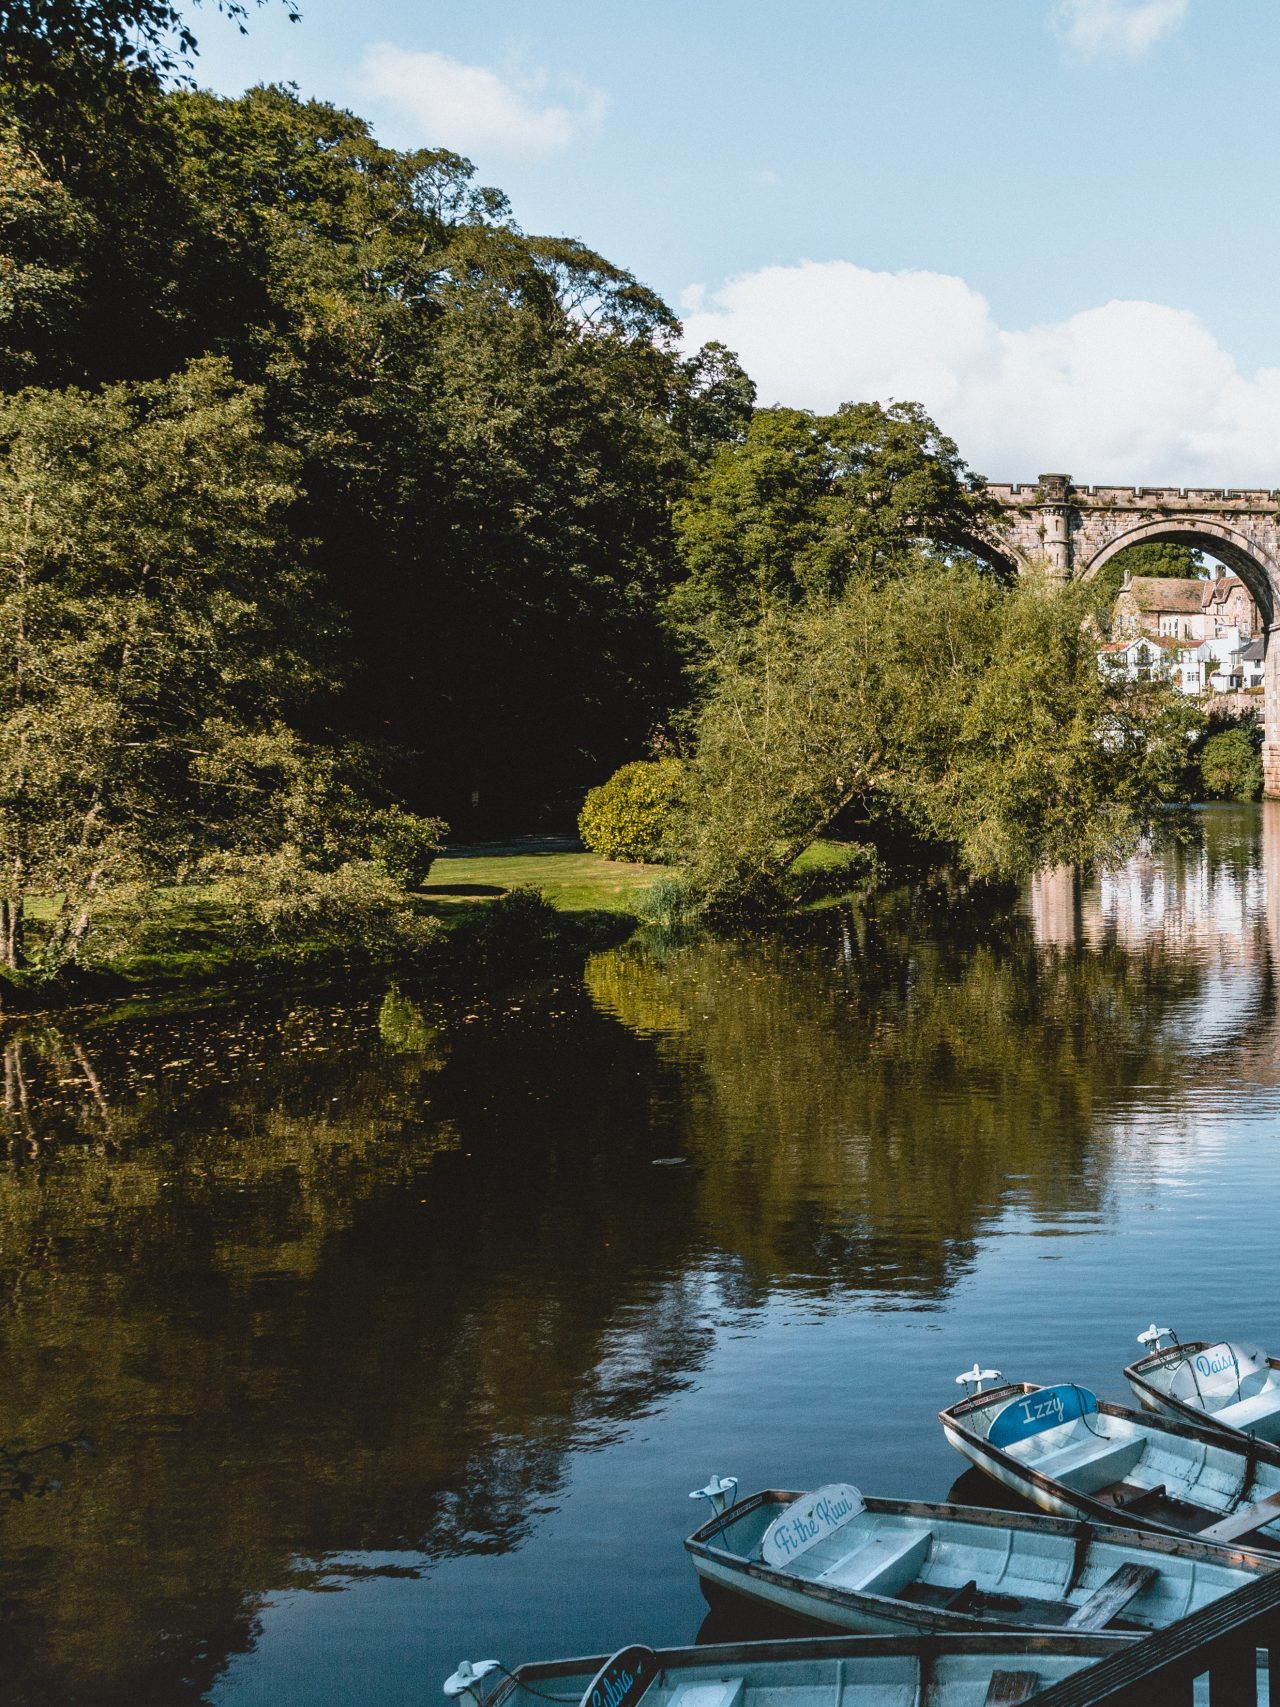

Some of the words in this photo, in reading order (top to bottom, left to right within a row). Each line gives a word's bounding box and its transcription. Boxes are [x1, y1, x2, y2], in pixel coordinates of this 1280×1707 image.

[1196, 1353, 1239, 1377] Daisy
[1019, 1396, 1064, 1422] Izzy
[774, 1526, 798, 1554] Fi
[793, 1517, 820, 1544] the
